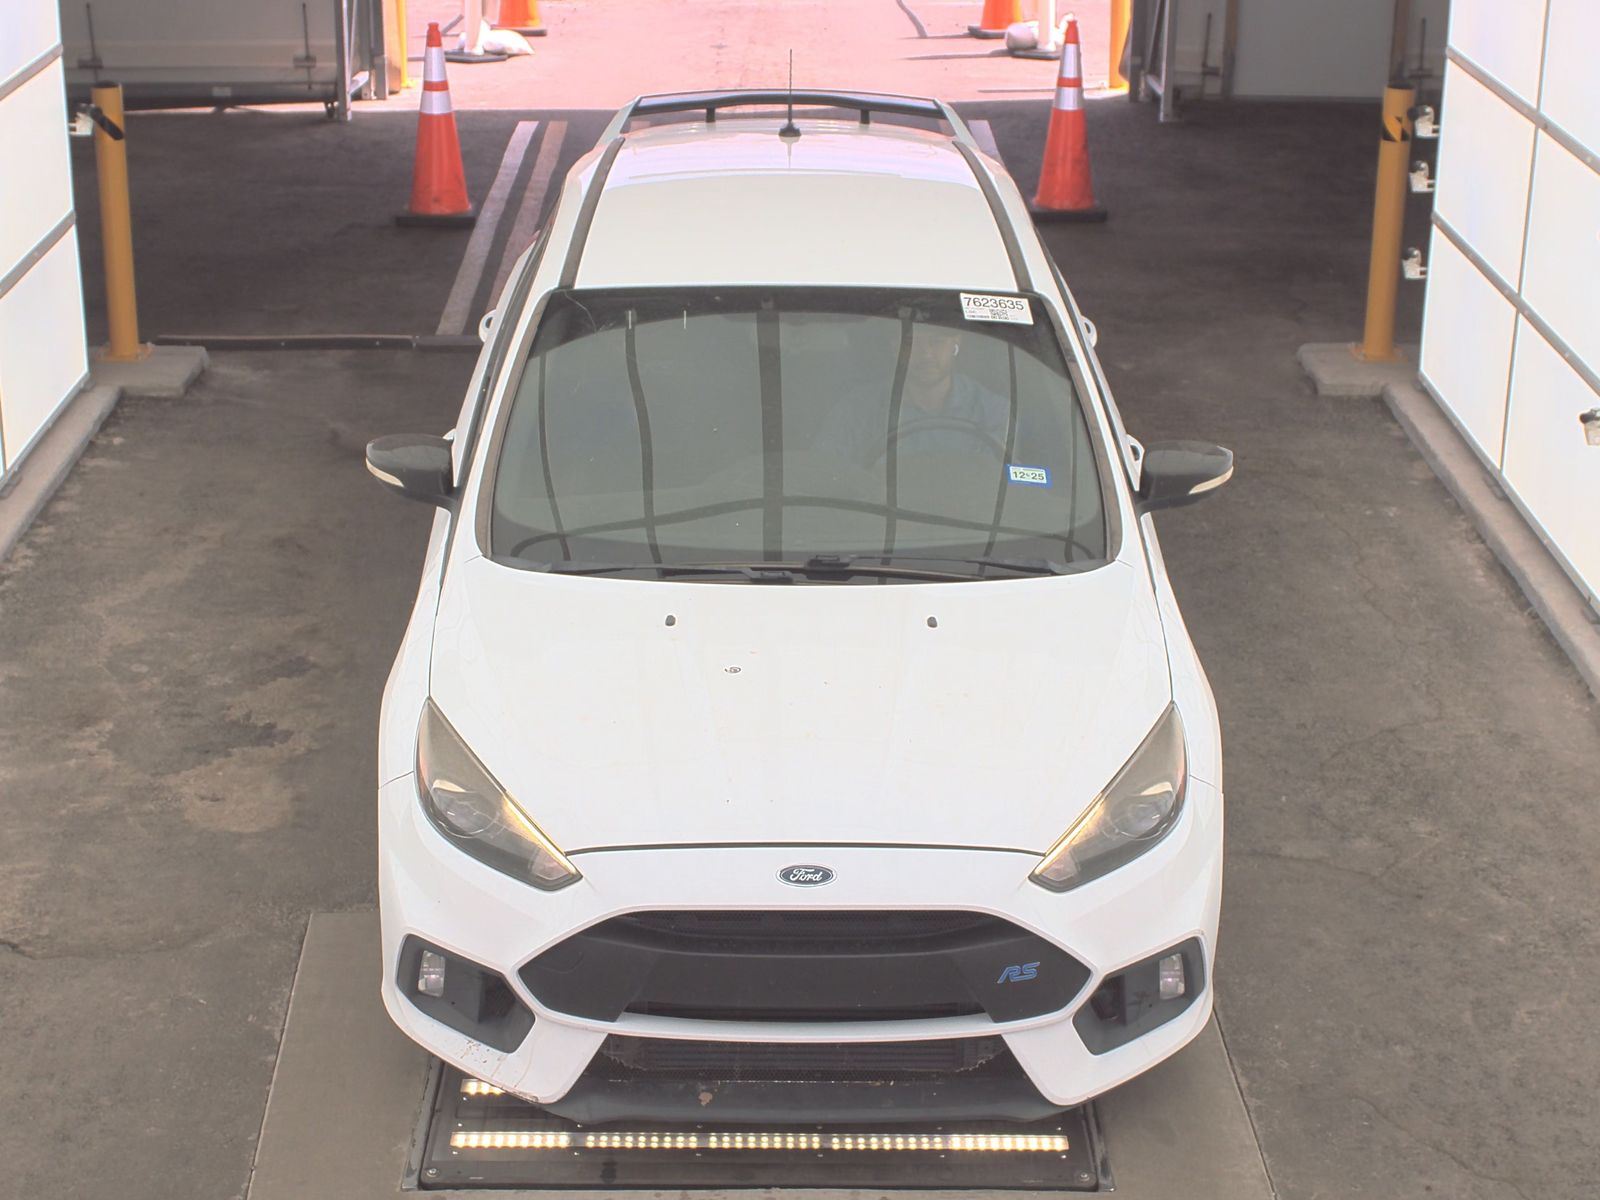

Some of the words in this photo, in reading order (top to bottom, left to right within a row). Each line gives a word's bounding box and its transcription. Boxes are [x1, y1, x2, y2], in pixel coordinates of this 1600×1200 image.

[963, 296, 1024, 310] 7623635
[789, 868, 823, 881] Ford
[996, 961, 1041, 984] RS
